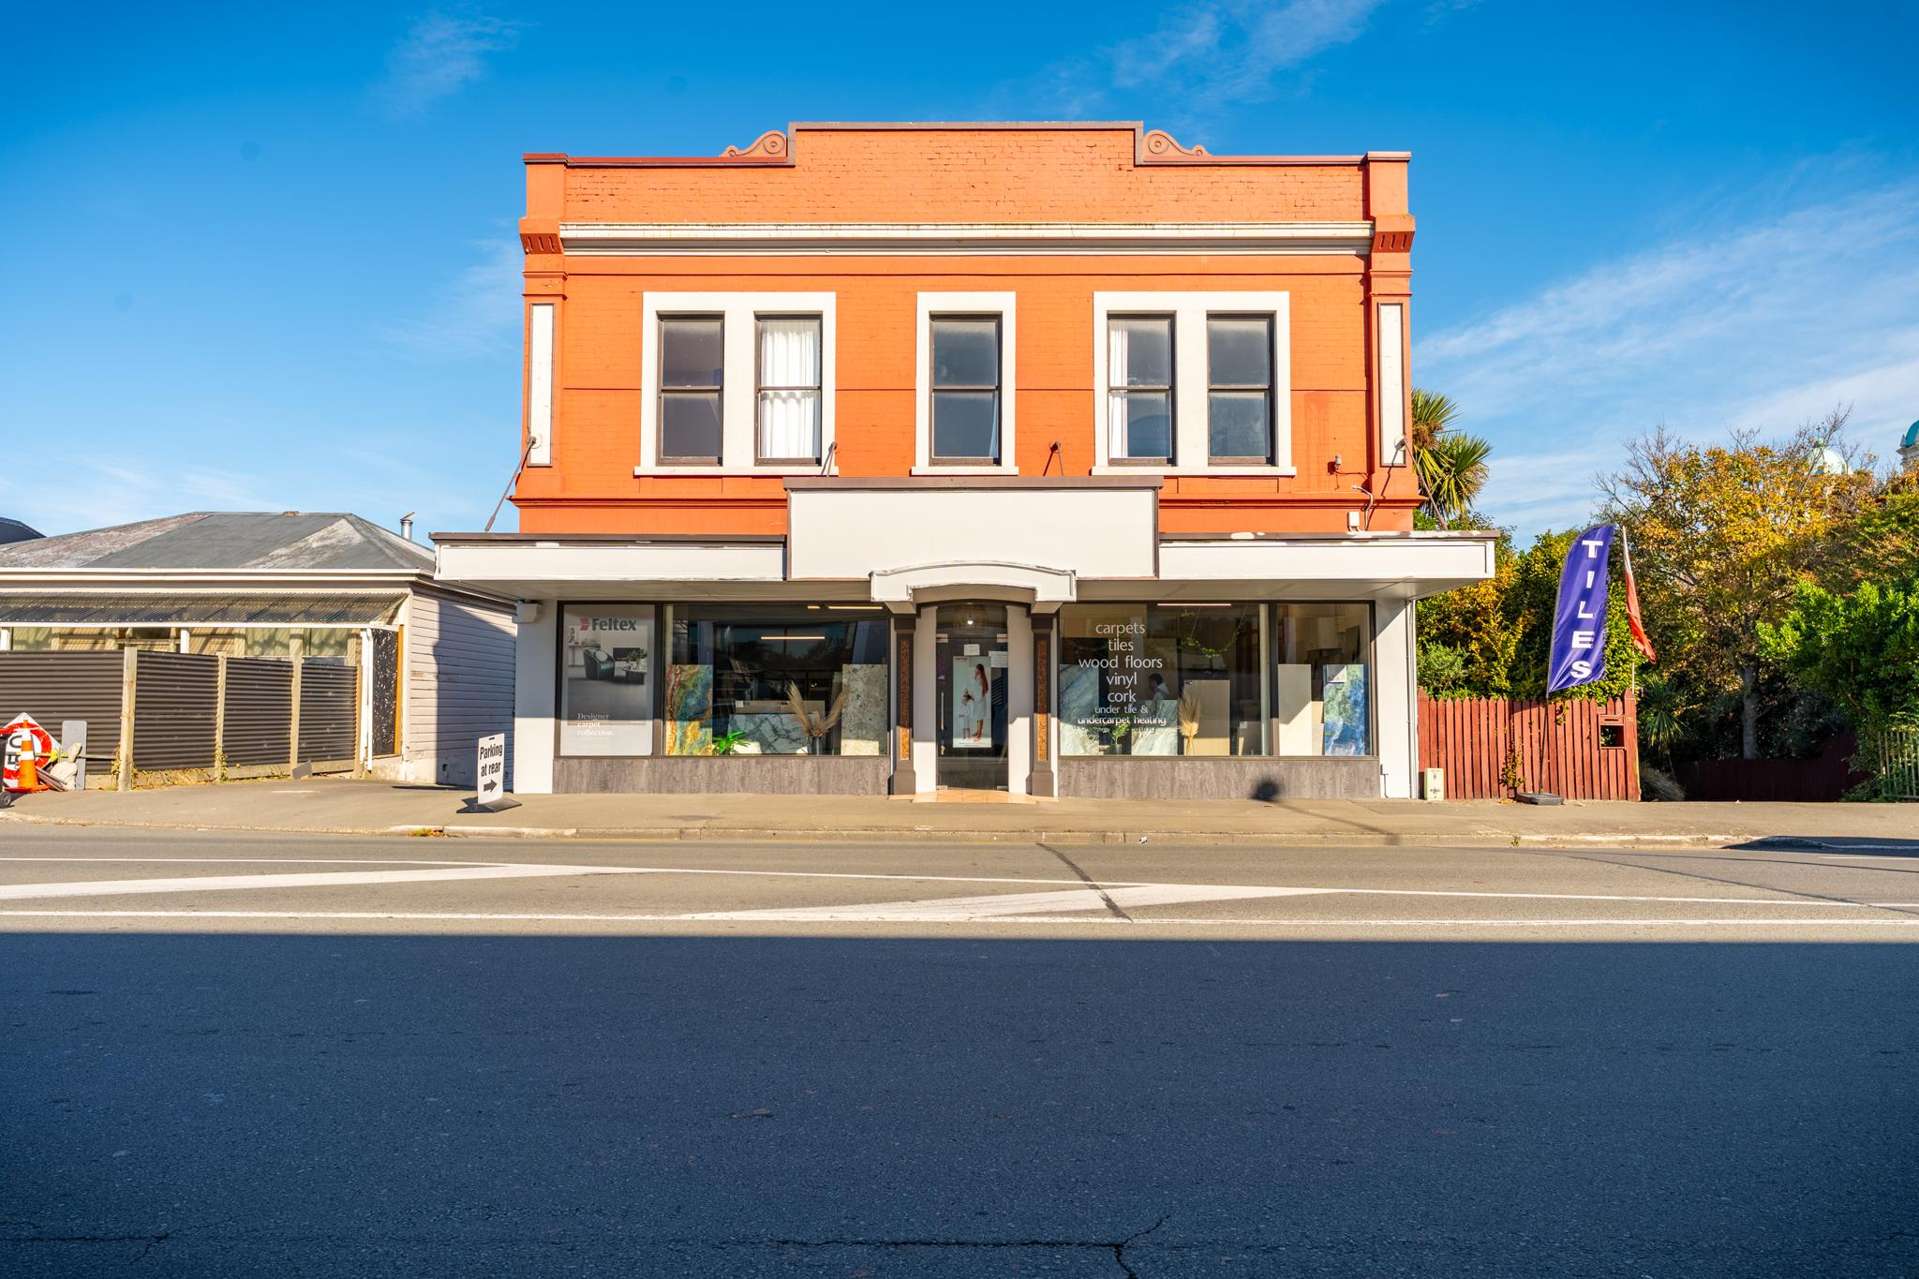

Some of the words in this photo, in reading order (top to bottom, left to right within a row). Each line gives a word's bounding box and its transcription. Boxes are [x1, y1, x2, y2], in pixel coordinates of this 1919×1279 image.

[1570, 540, 1604, 679] TILES
[591, 617, 637, 631] Feltex
[1095, 622, 1146, 637] carpets
[1108, 638, 1134, 651] tiles
[1078, 655, 1118, 668] wood
[1125, 655, 1163, 668] floors
[1106, 672, 1137, 689] vinyl
[1107, 689, 1136, 702] cork
[1095, 705, 1119, 714] under
[1124, 705, 1137, 714] tile
[1141, 705, 1148, 714] &
[576, 712, 609, 721] Designer
[1077, 716, 1131, 726] undercarpet
[1133, 716, 1167, 726] heating
[479, 743, 503, 760] Parking
[481, 763, 488, 777] at
[488, 762, 501, 775] rear
